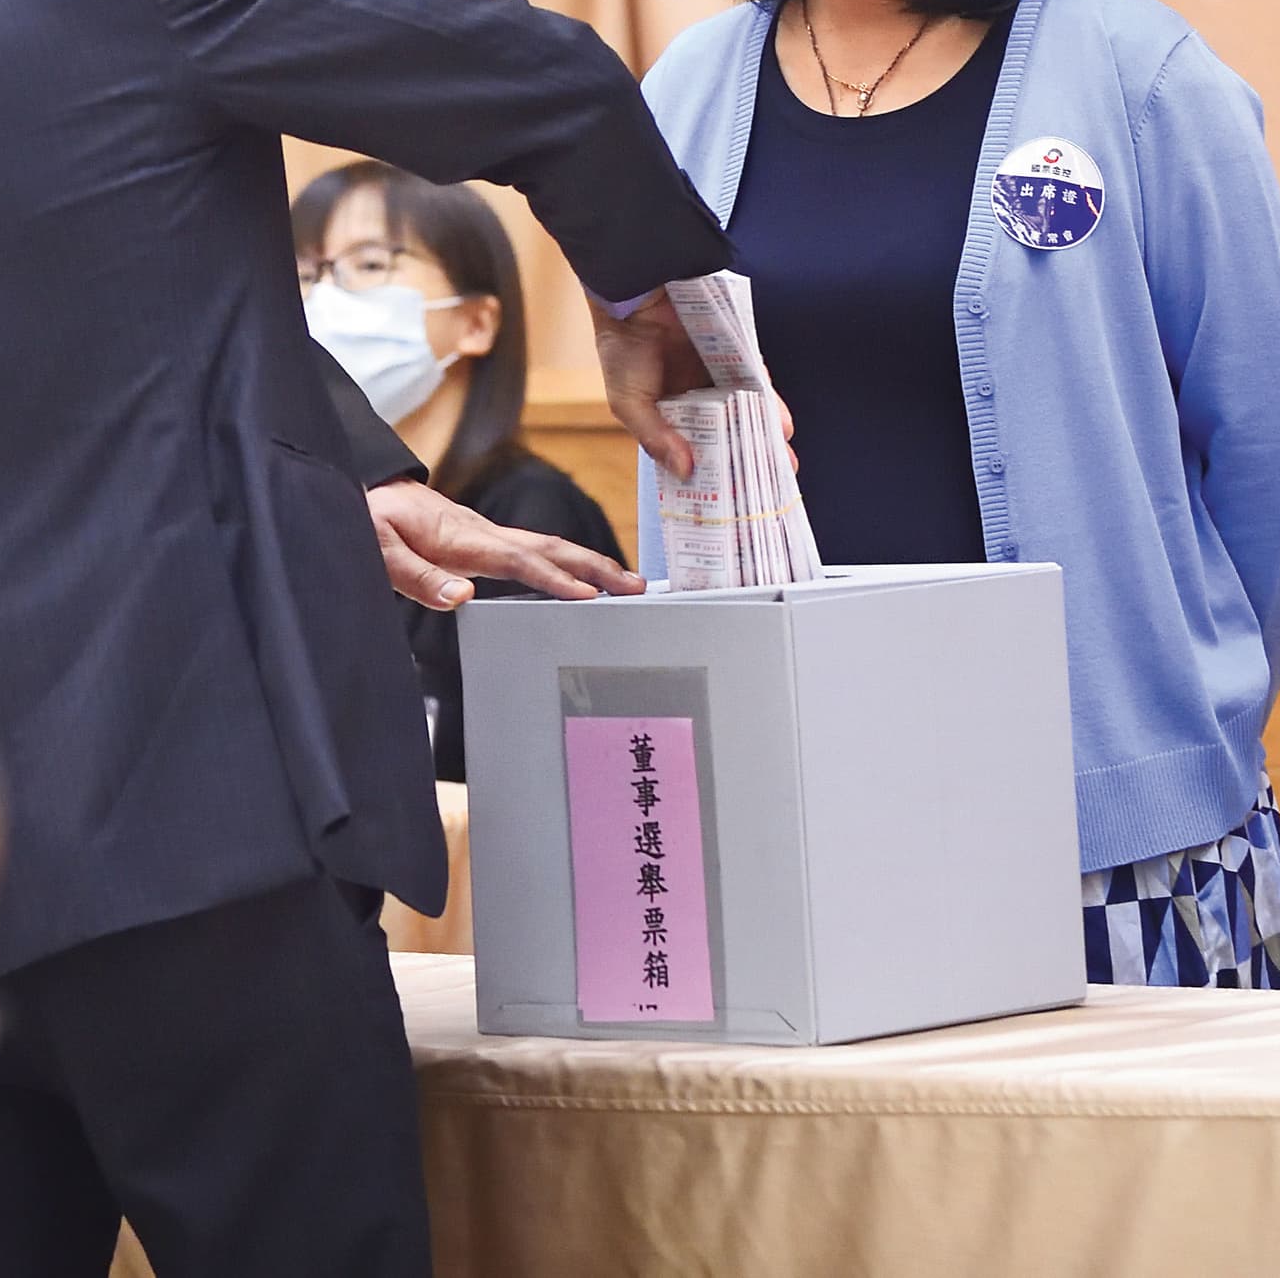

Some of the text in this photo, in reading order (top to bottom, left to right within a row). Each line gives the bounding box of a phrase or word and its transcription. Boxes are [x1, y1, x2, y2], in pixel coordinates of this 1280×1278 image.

[1019, 182, 1078, 205] 出席證
[628, 733, 670, 989] 董事選舉票箱
